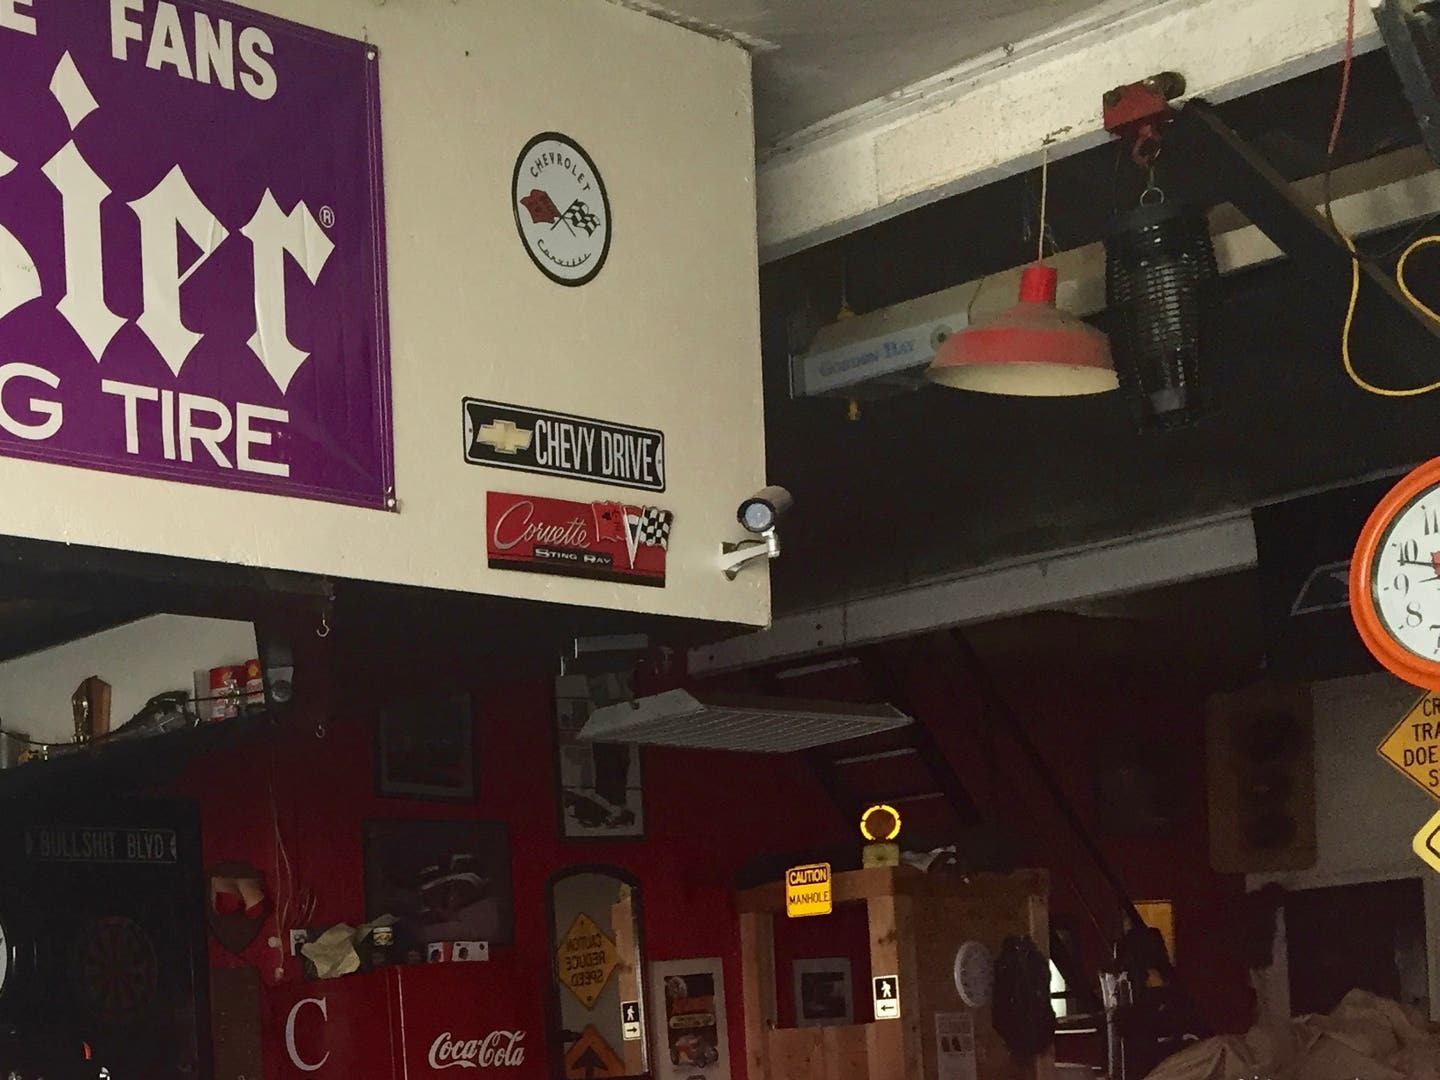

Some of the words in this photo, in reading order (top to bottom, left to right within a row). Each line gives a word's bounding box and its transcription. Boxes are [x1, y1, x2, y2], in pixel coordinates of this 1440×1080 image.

[110, 0, 277, 100] FANS
[530, 152, 591, 192] CHEVROLET
[101, 379, 290, 477] TIRE
[534, 419, 596, 472] CHEVY
[601, 430, 653, 482] DRIVE
[493, 501, 592, 549] Corvette
[535, 548, 578, 560] STING
[583, 553, 611, 564] RAY
[1394, 573, 1409, 596] 9
[1406, 600, 1423, 627] 8
[40, 830, 116, 857] BULLSHIT
[127, 833, 164, 860] BLVD
[790, 869, 827, 885] CAUTION
[789, 890, 829, 905] MANHOLE
[428, 1030, 526, 1070] Coca-Cola
